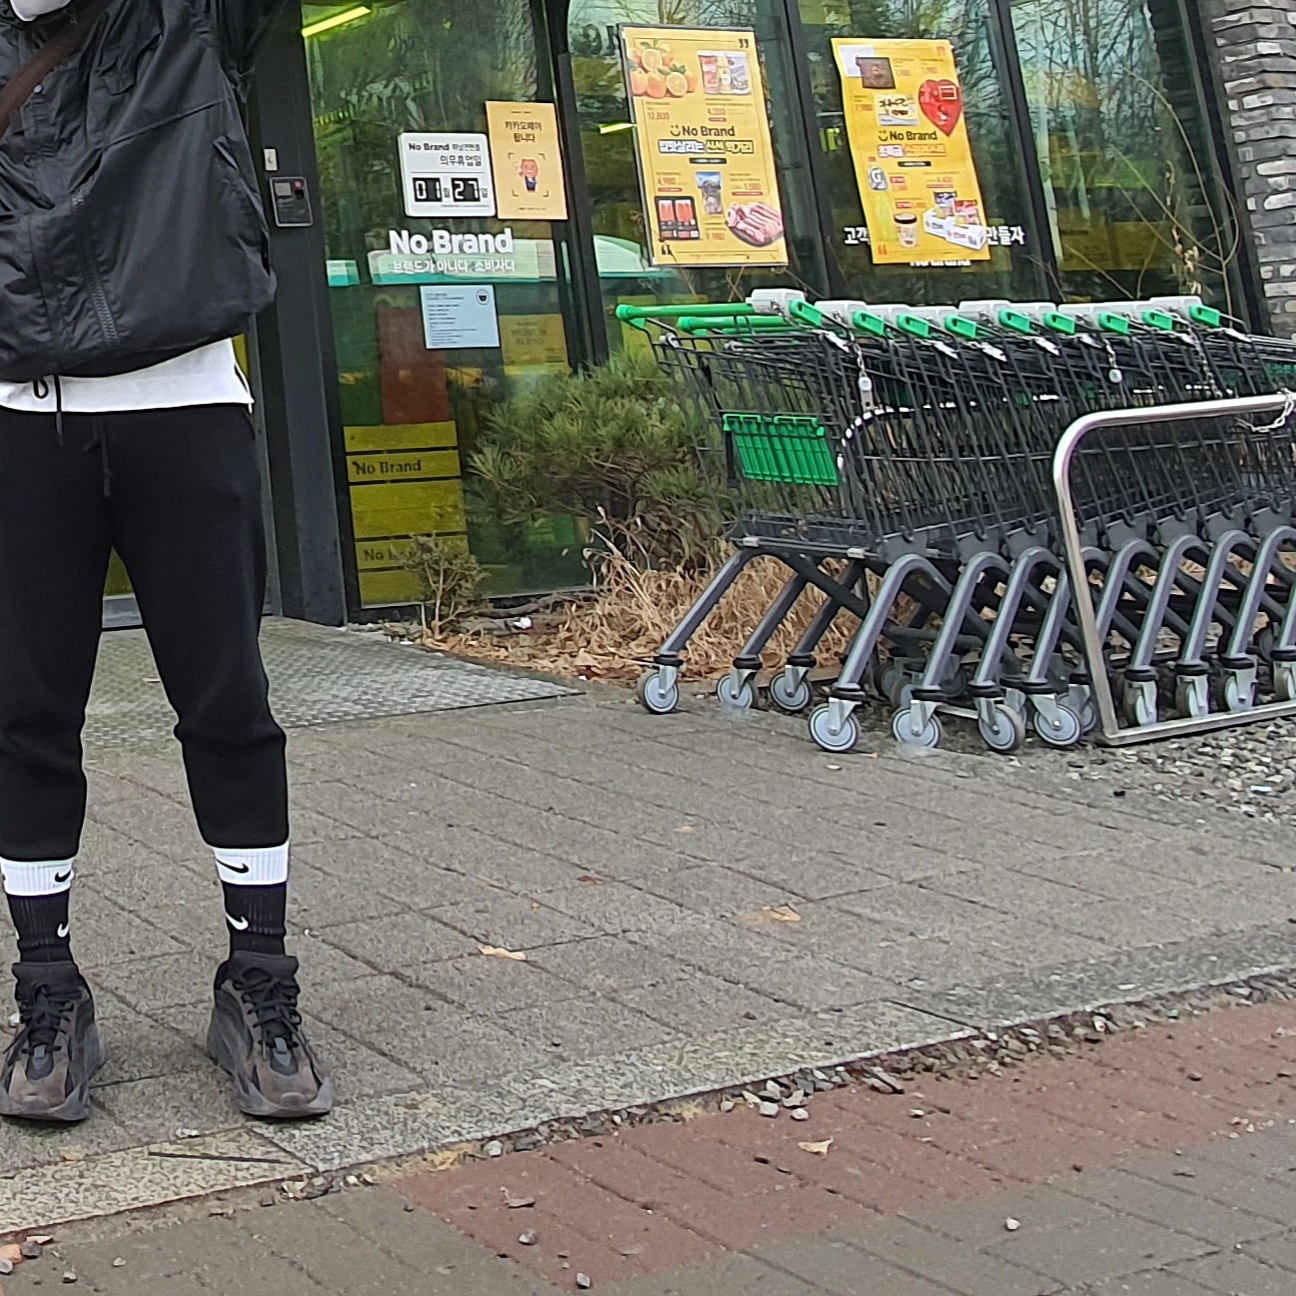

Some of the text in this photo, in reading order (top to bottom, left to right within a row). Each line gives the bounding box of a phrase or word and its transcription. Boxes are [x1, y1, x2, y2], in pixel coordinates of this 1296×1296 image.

[682, 125, 735, 136] No Brand
[889, 131, 938, 141] No Brand
[408, 142, 422, 151] No
[423, 142, 449, 151] Brand
[414, 180, 441, 199] 01
[453, 180, 479, 199] 27
[389, 228, 513, 254] No Brand
[393, 259, 435, 274] 브랜드가
[475, 259, 515, 272] 소비자다
[355, 459, 422, 475] No Brand
[364, 549, 384, 561] No
